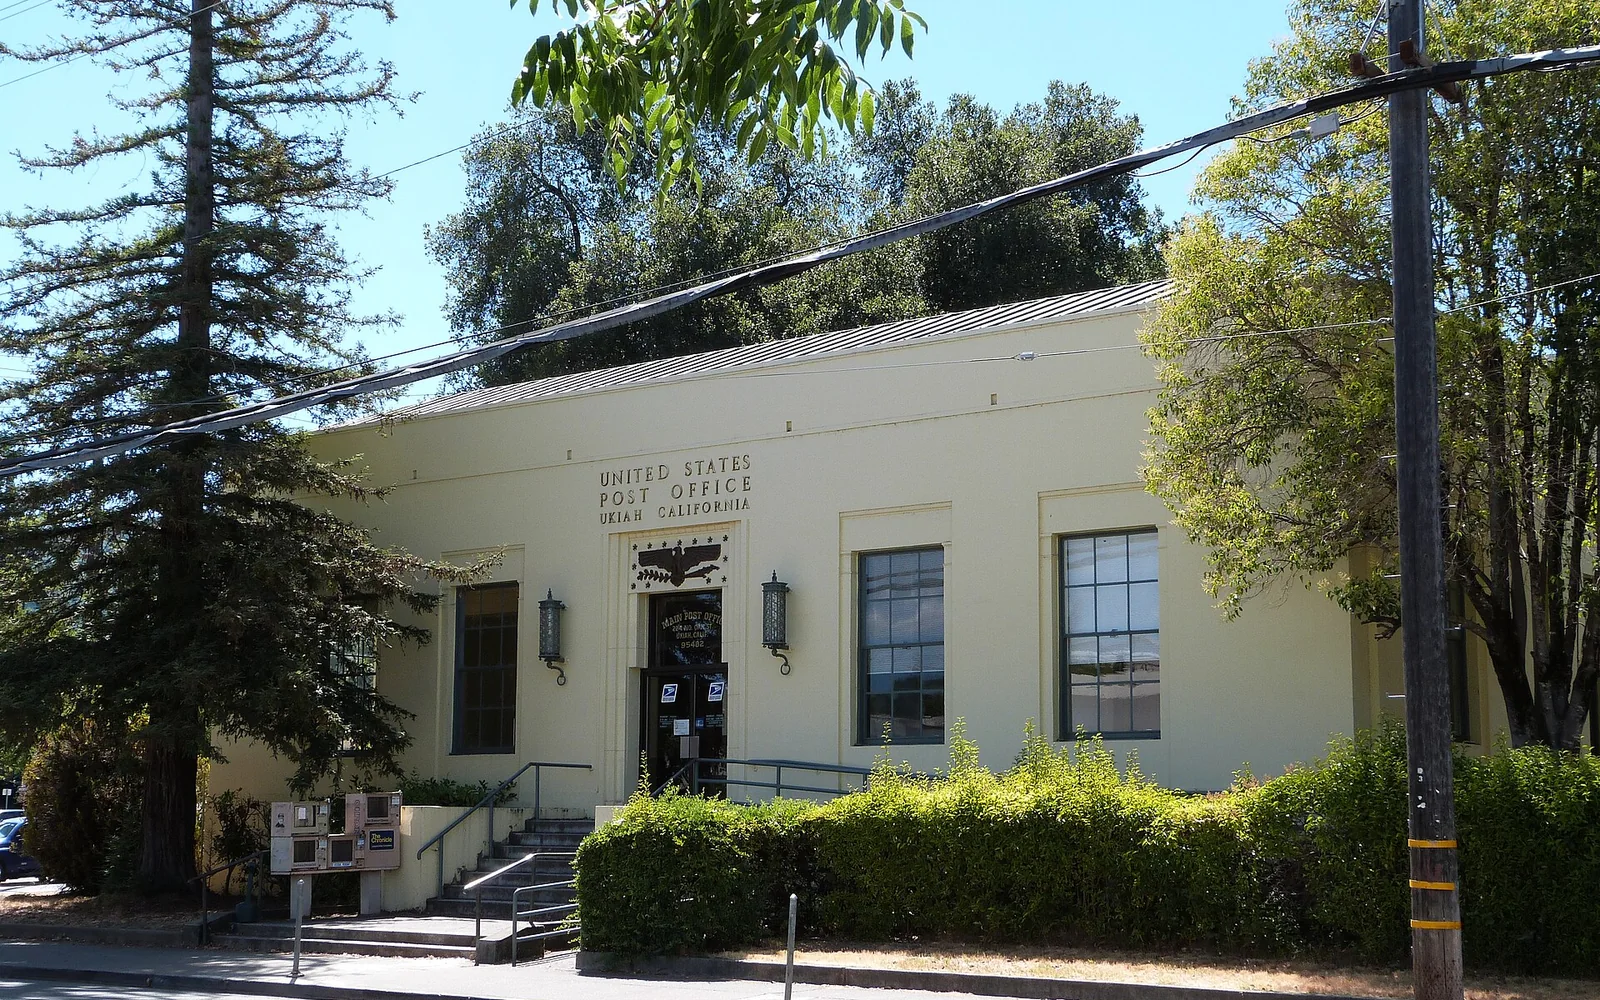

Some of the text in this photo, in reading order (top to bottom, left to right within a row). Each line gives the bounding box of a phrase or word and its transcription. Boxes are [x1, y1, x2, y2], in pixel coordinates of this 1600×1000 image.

[600, 454, 750, 487] UNITED STATES
[600, 476, 751, 508] POST OFFICE
[600, 497, 750, 525] UKIAH CALIFORNIA
[661, 611, 722, 629] MAIN POST OFFIC
[371, 836, 393, 844] Chronicle
